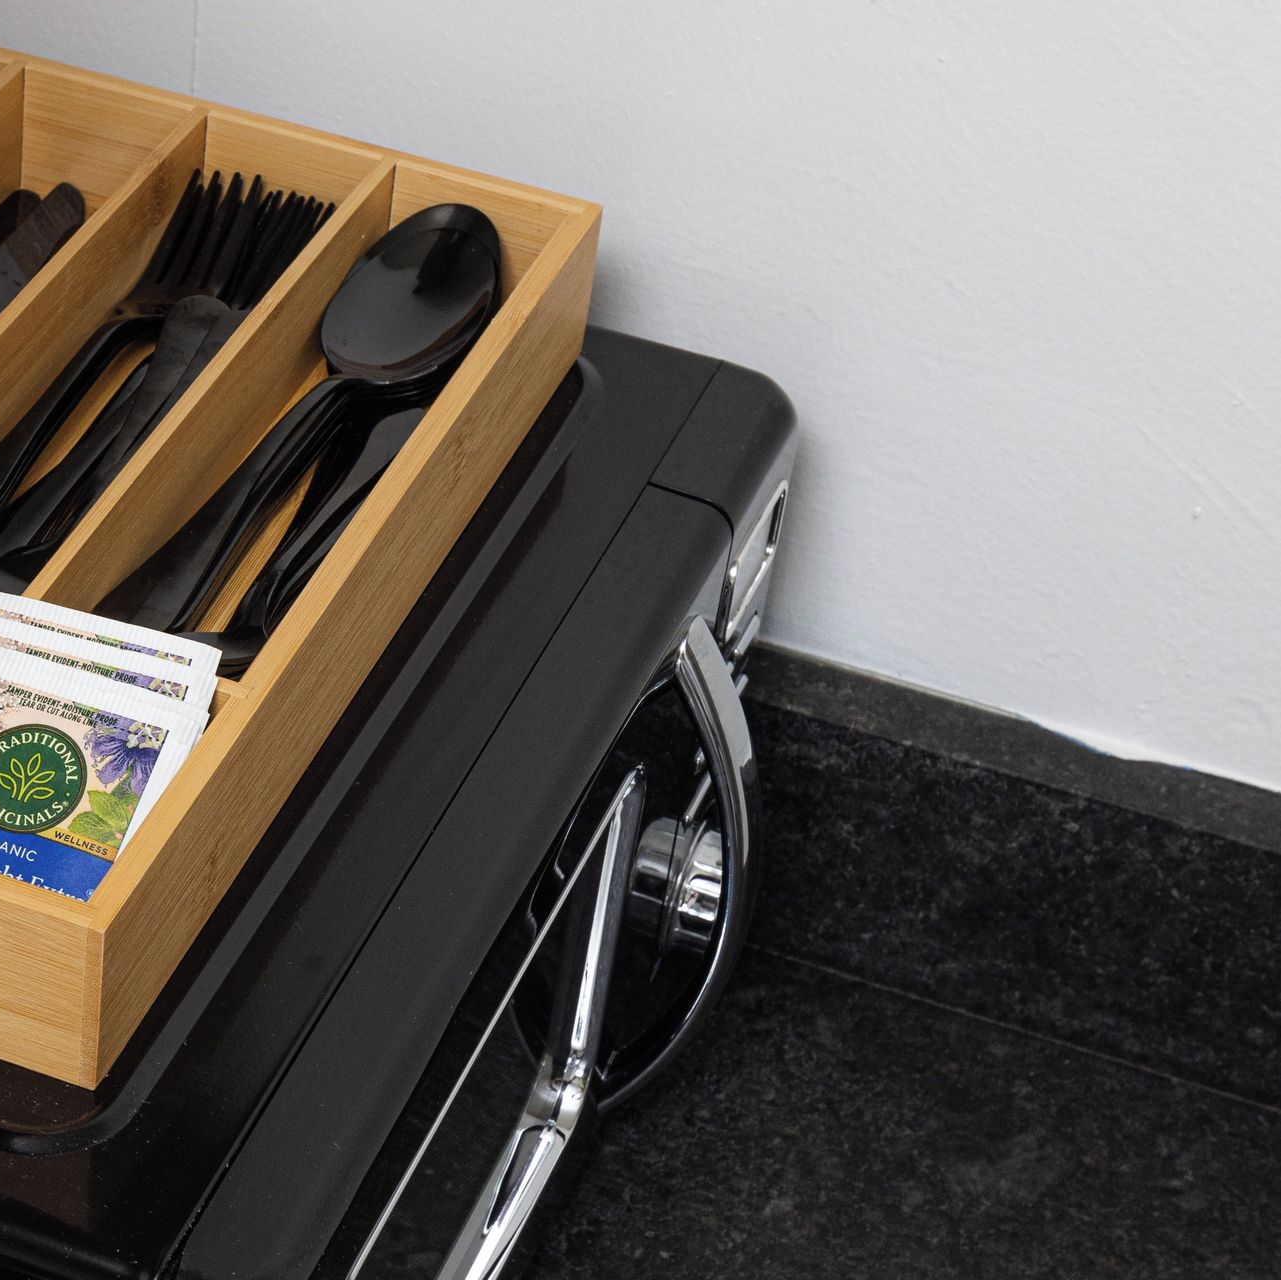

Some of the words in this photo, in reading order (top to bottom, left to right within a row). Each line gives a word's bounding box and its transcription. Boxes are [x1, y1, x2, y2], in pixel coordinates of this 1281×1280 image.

[25, 647, 51, 662] TAMPER
[114, 671, 138, 684] PROOF
[7, 684, 33, 700] TAMPER
[95, 710, 119, 726] PROOF
[18, 697, 35, 709] TEAR
[36, 702, 46, 712] OR
[46, 705, 59, 716] CUT
[59, 708, 82, 723] ALONG
[82, 716, 99, 728] LINE
[54, 830, 109, 856] WELLNESS
